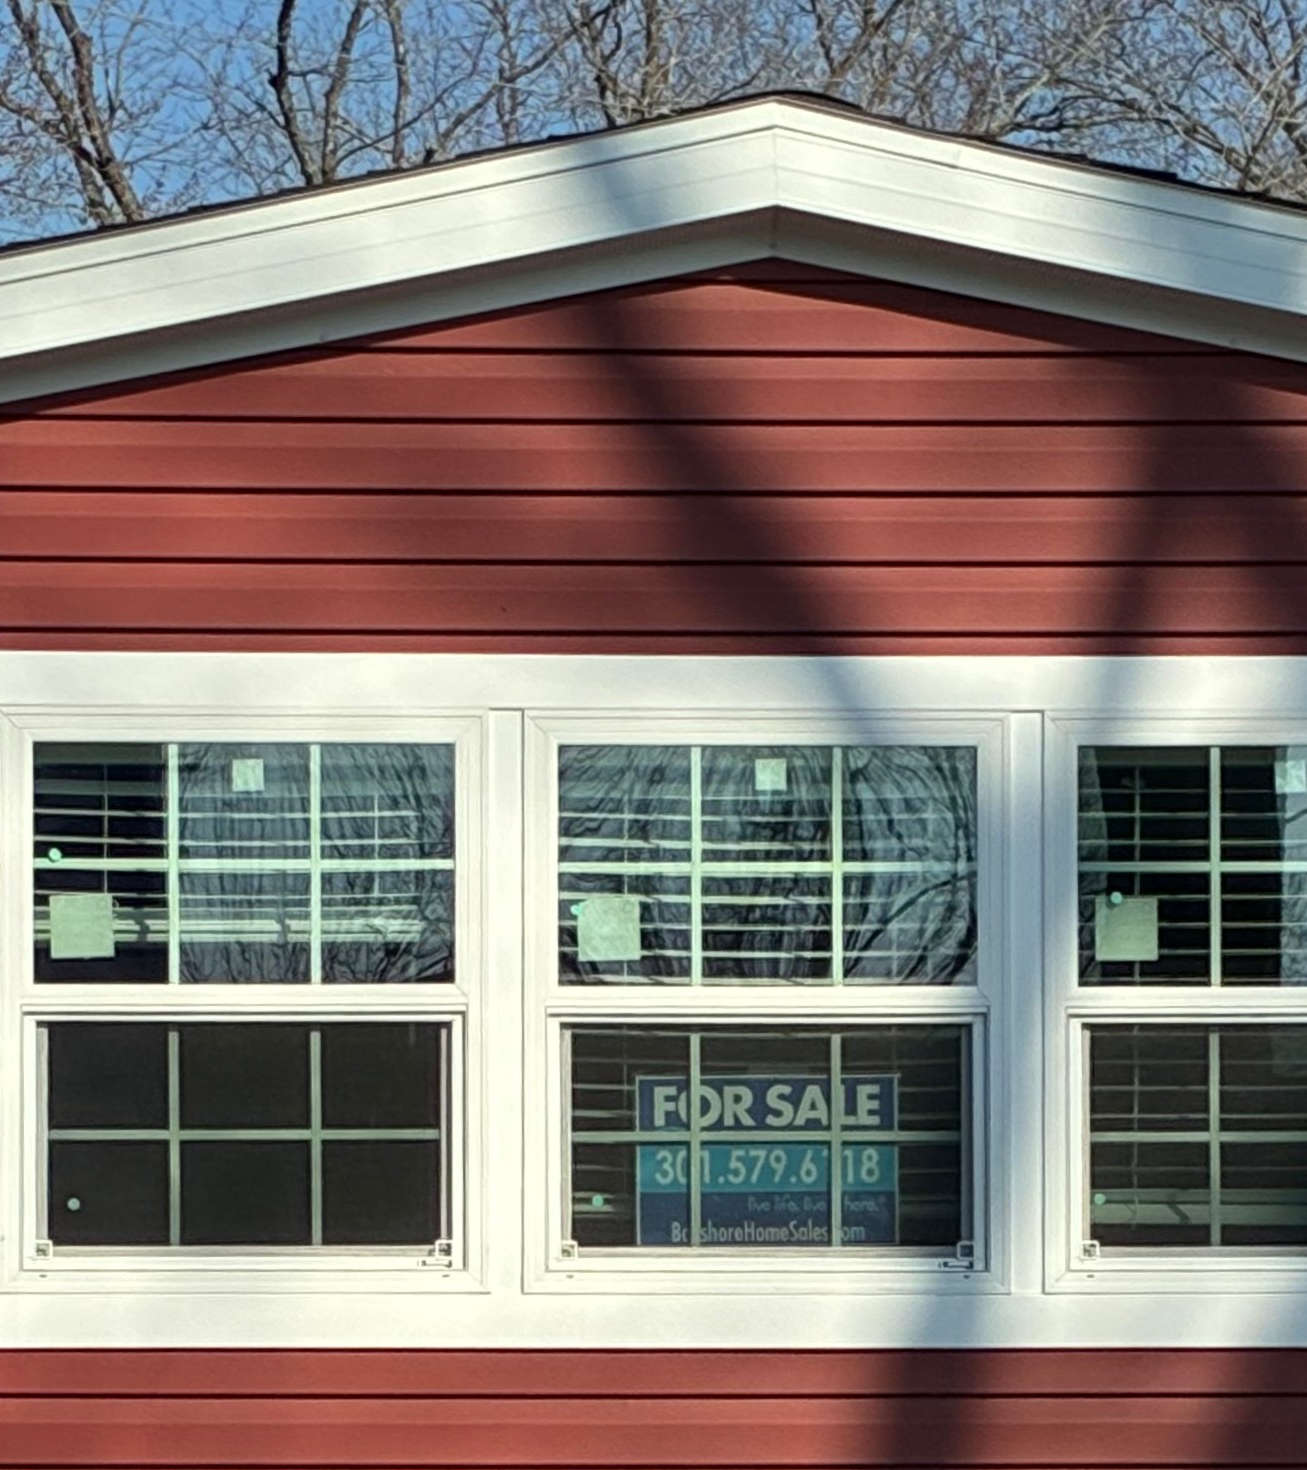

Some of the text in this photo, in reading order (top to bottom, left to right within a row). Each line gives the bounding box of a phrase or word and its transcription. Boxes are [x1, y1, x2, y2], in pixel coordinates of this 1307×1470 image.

[653, 1084, 881, 1128] FOR SALE
[654, 1148, 880, 1186] 301.579.618
[671, 1218, 866, 1243] BshoreHomeSalesom
